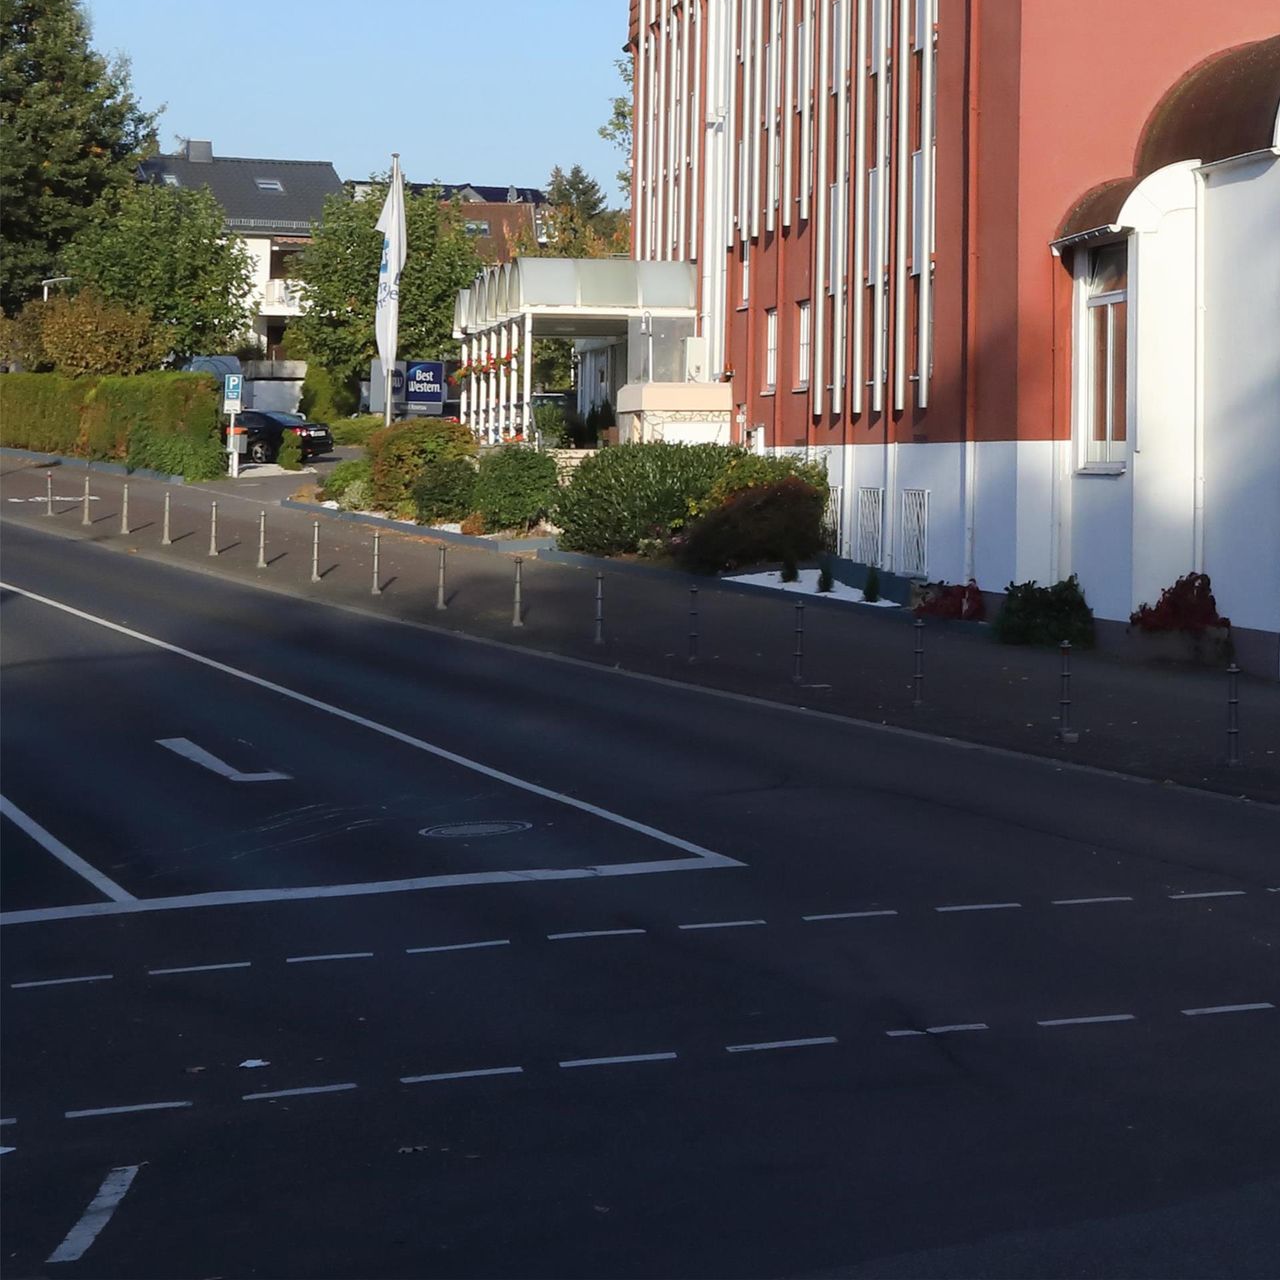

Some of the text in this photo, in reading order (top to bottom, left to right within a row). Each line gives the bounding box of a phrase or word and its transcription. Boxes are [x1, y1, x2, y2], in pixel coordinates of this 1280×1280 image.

[415, 369, 434, 381] Best
[229, 376, 239, 390] P
[408, 380, 440, 392] Western
